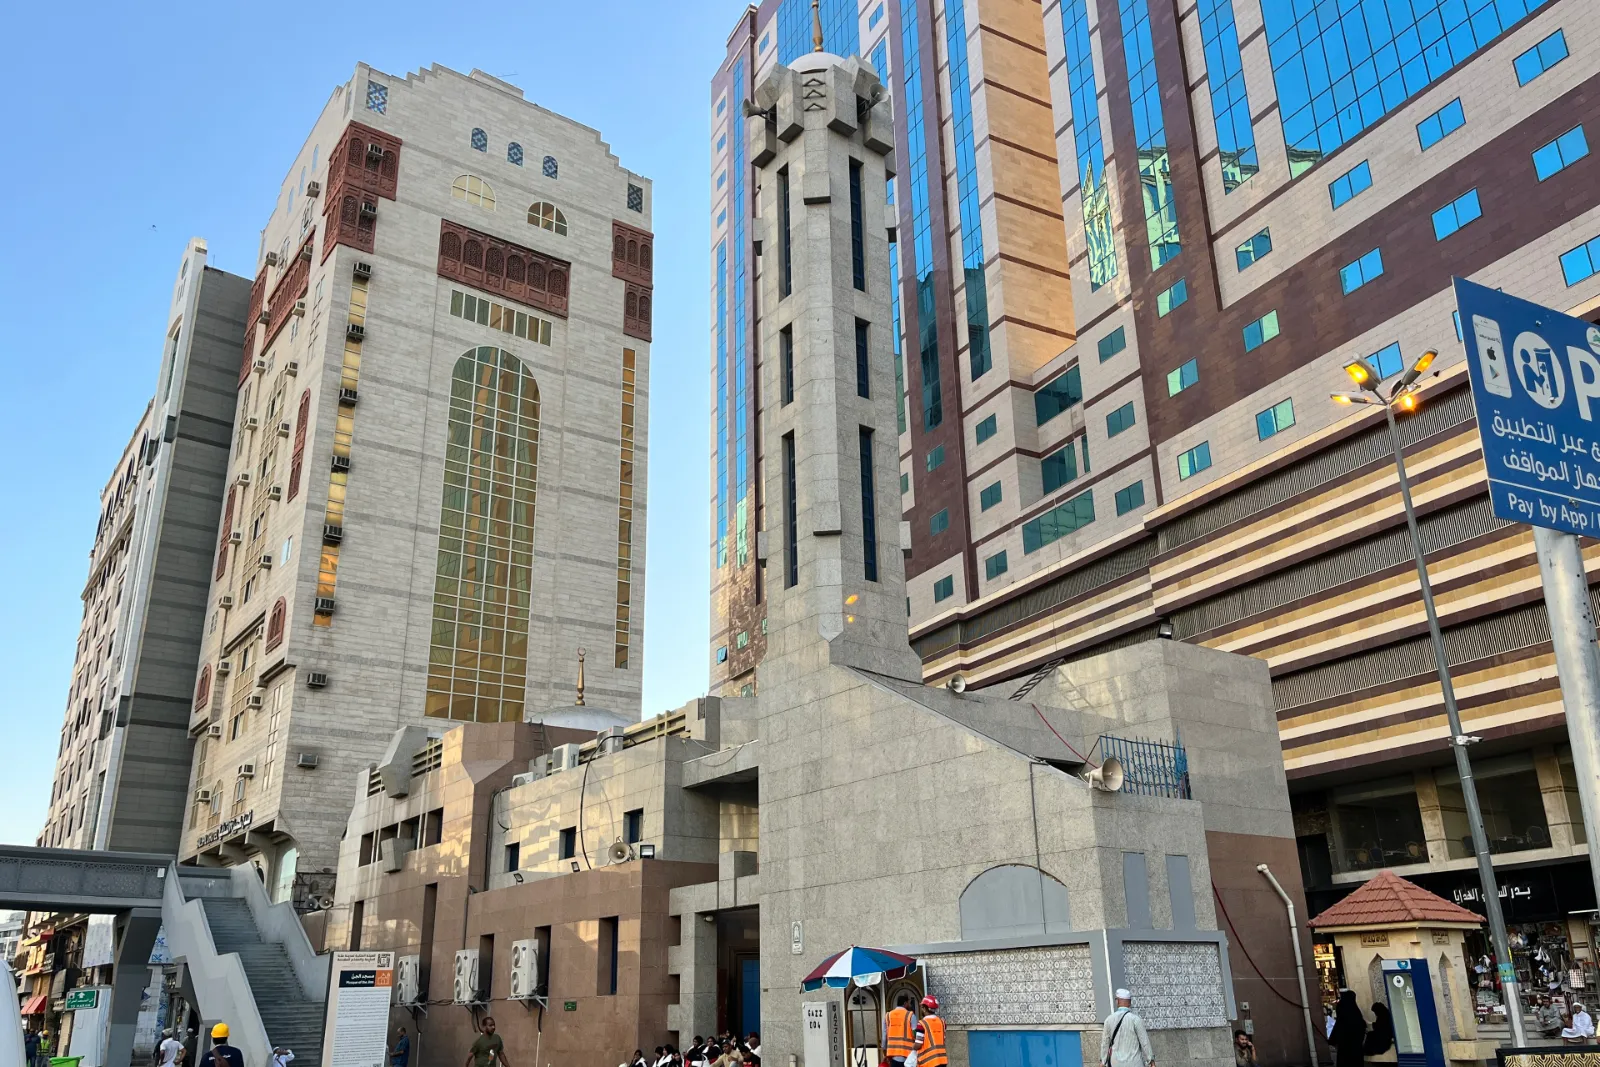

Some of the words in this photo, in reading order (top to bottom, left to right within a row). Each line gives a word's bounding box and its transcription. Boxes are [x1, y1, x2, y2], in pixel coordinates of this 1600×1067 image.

[1491, 409, 1557, 445] التطبيق
[1560, 433, 1587, 456] عبر
[1503, 448, 1570, 482] المواقف
[1573, 464, 1600, 490] هاز
[1507, 492, 1534, 519] Pay
[1539, 498, 1557, 524] by
[1561, 504, 1588, 530] App
[1453, 887, 1479, 904] الهدايا
[1510, 886, 1531, 900] بدر
[807, 1009, 823, 1018] GAZZ
